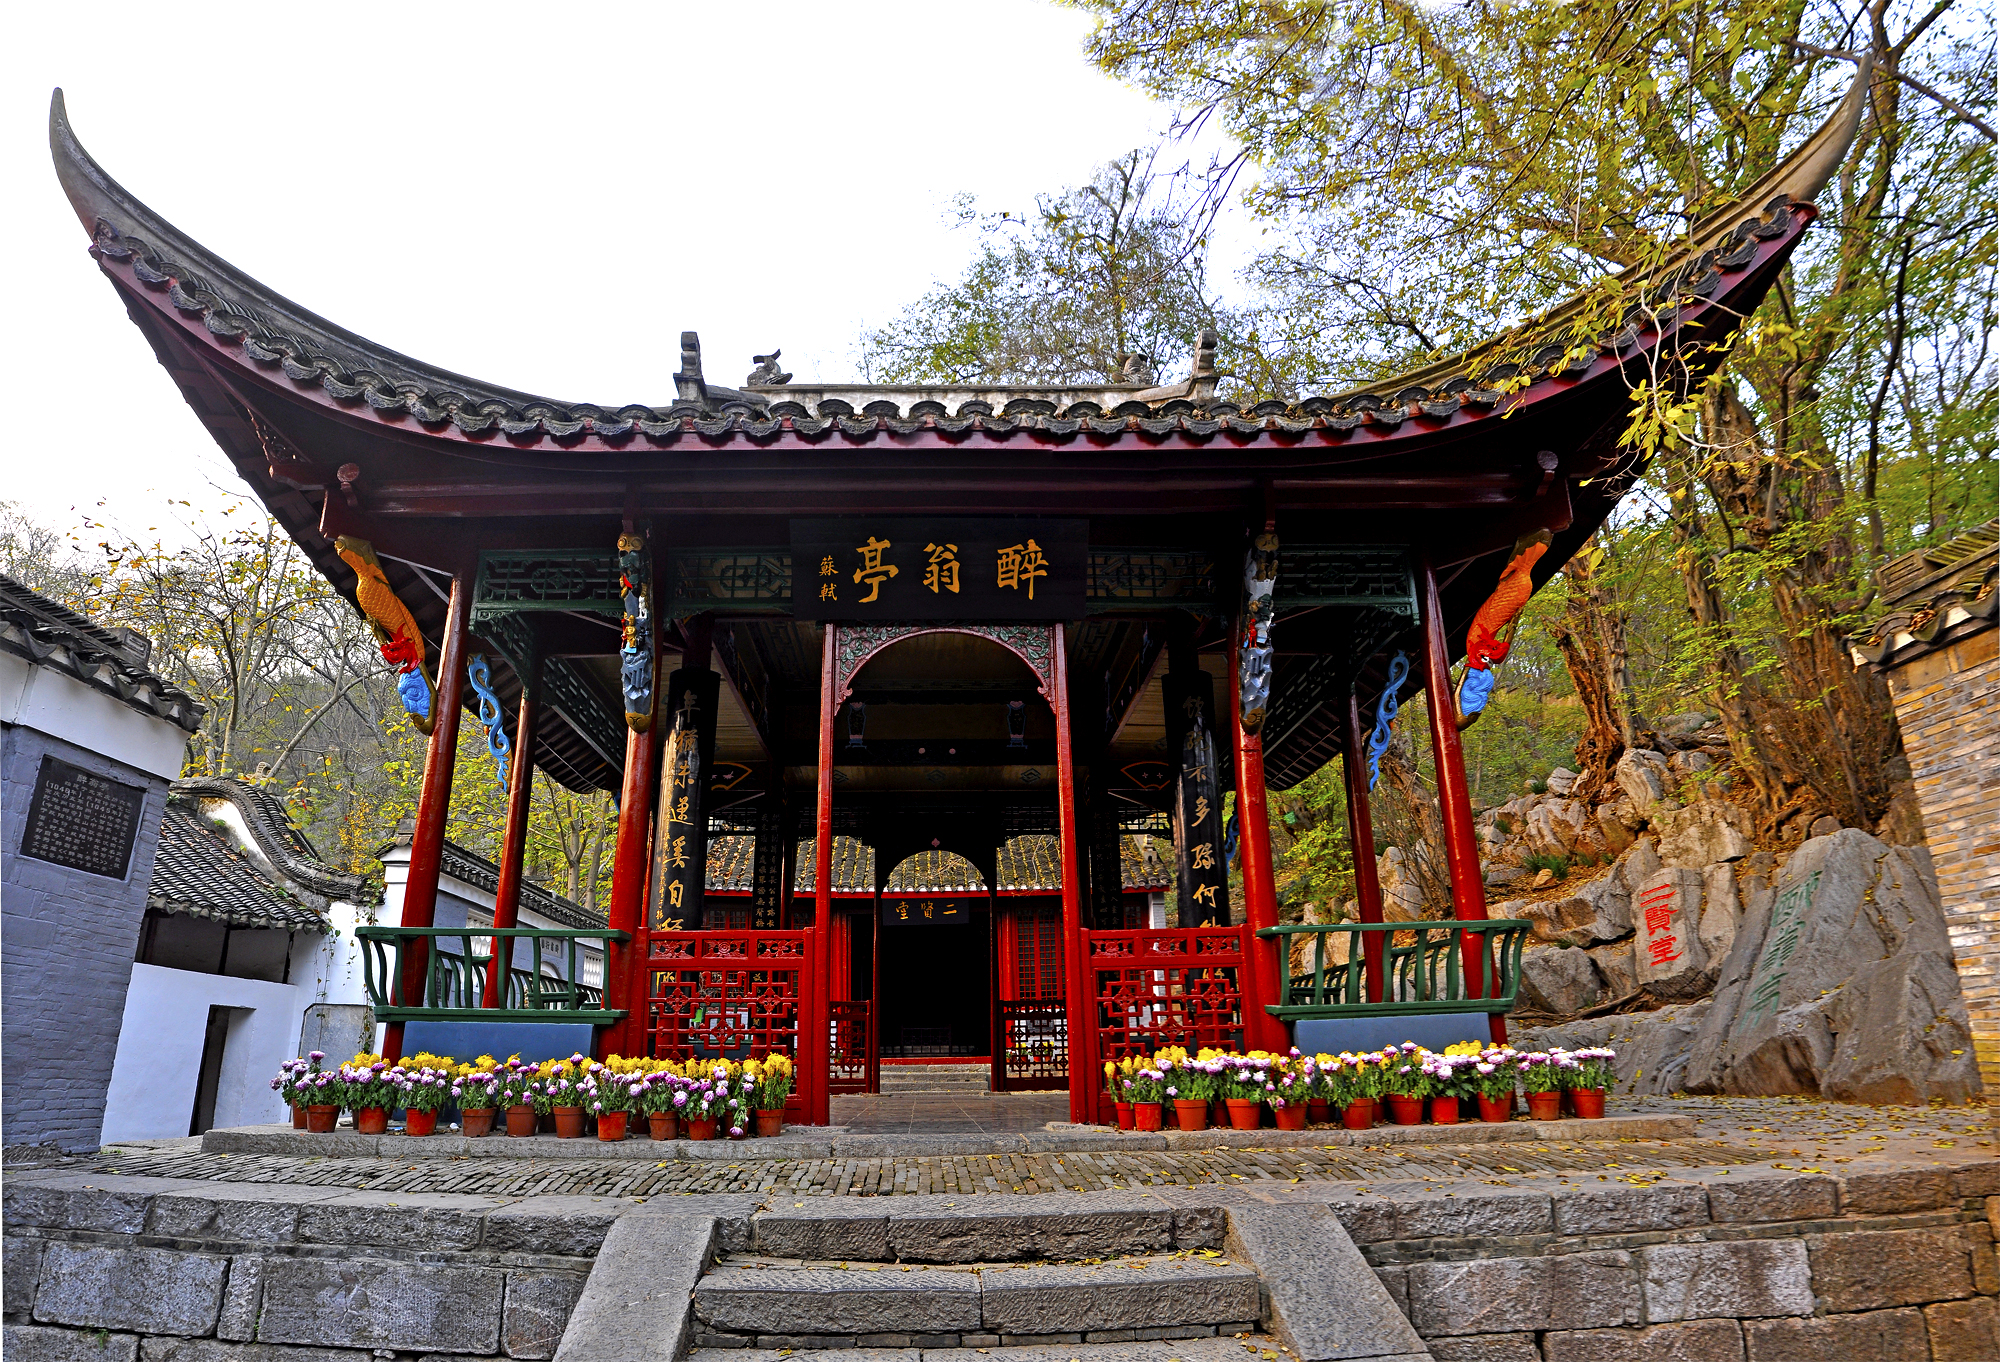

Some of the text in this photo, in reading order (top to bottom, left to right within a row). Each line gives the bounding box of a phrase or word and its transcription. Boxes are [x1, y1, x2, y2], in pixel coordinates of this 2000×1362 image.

[818, 554, 839, 602] 蘇軾
[853, 536, 1049, 603] 醉翁亭
[895, 901, 957, 920] 二賢堂
[1640, 883, 1683, 967] 二賢堂
